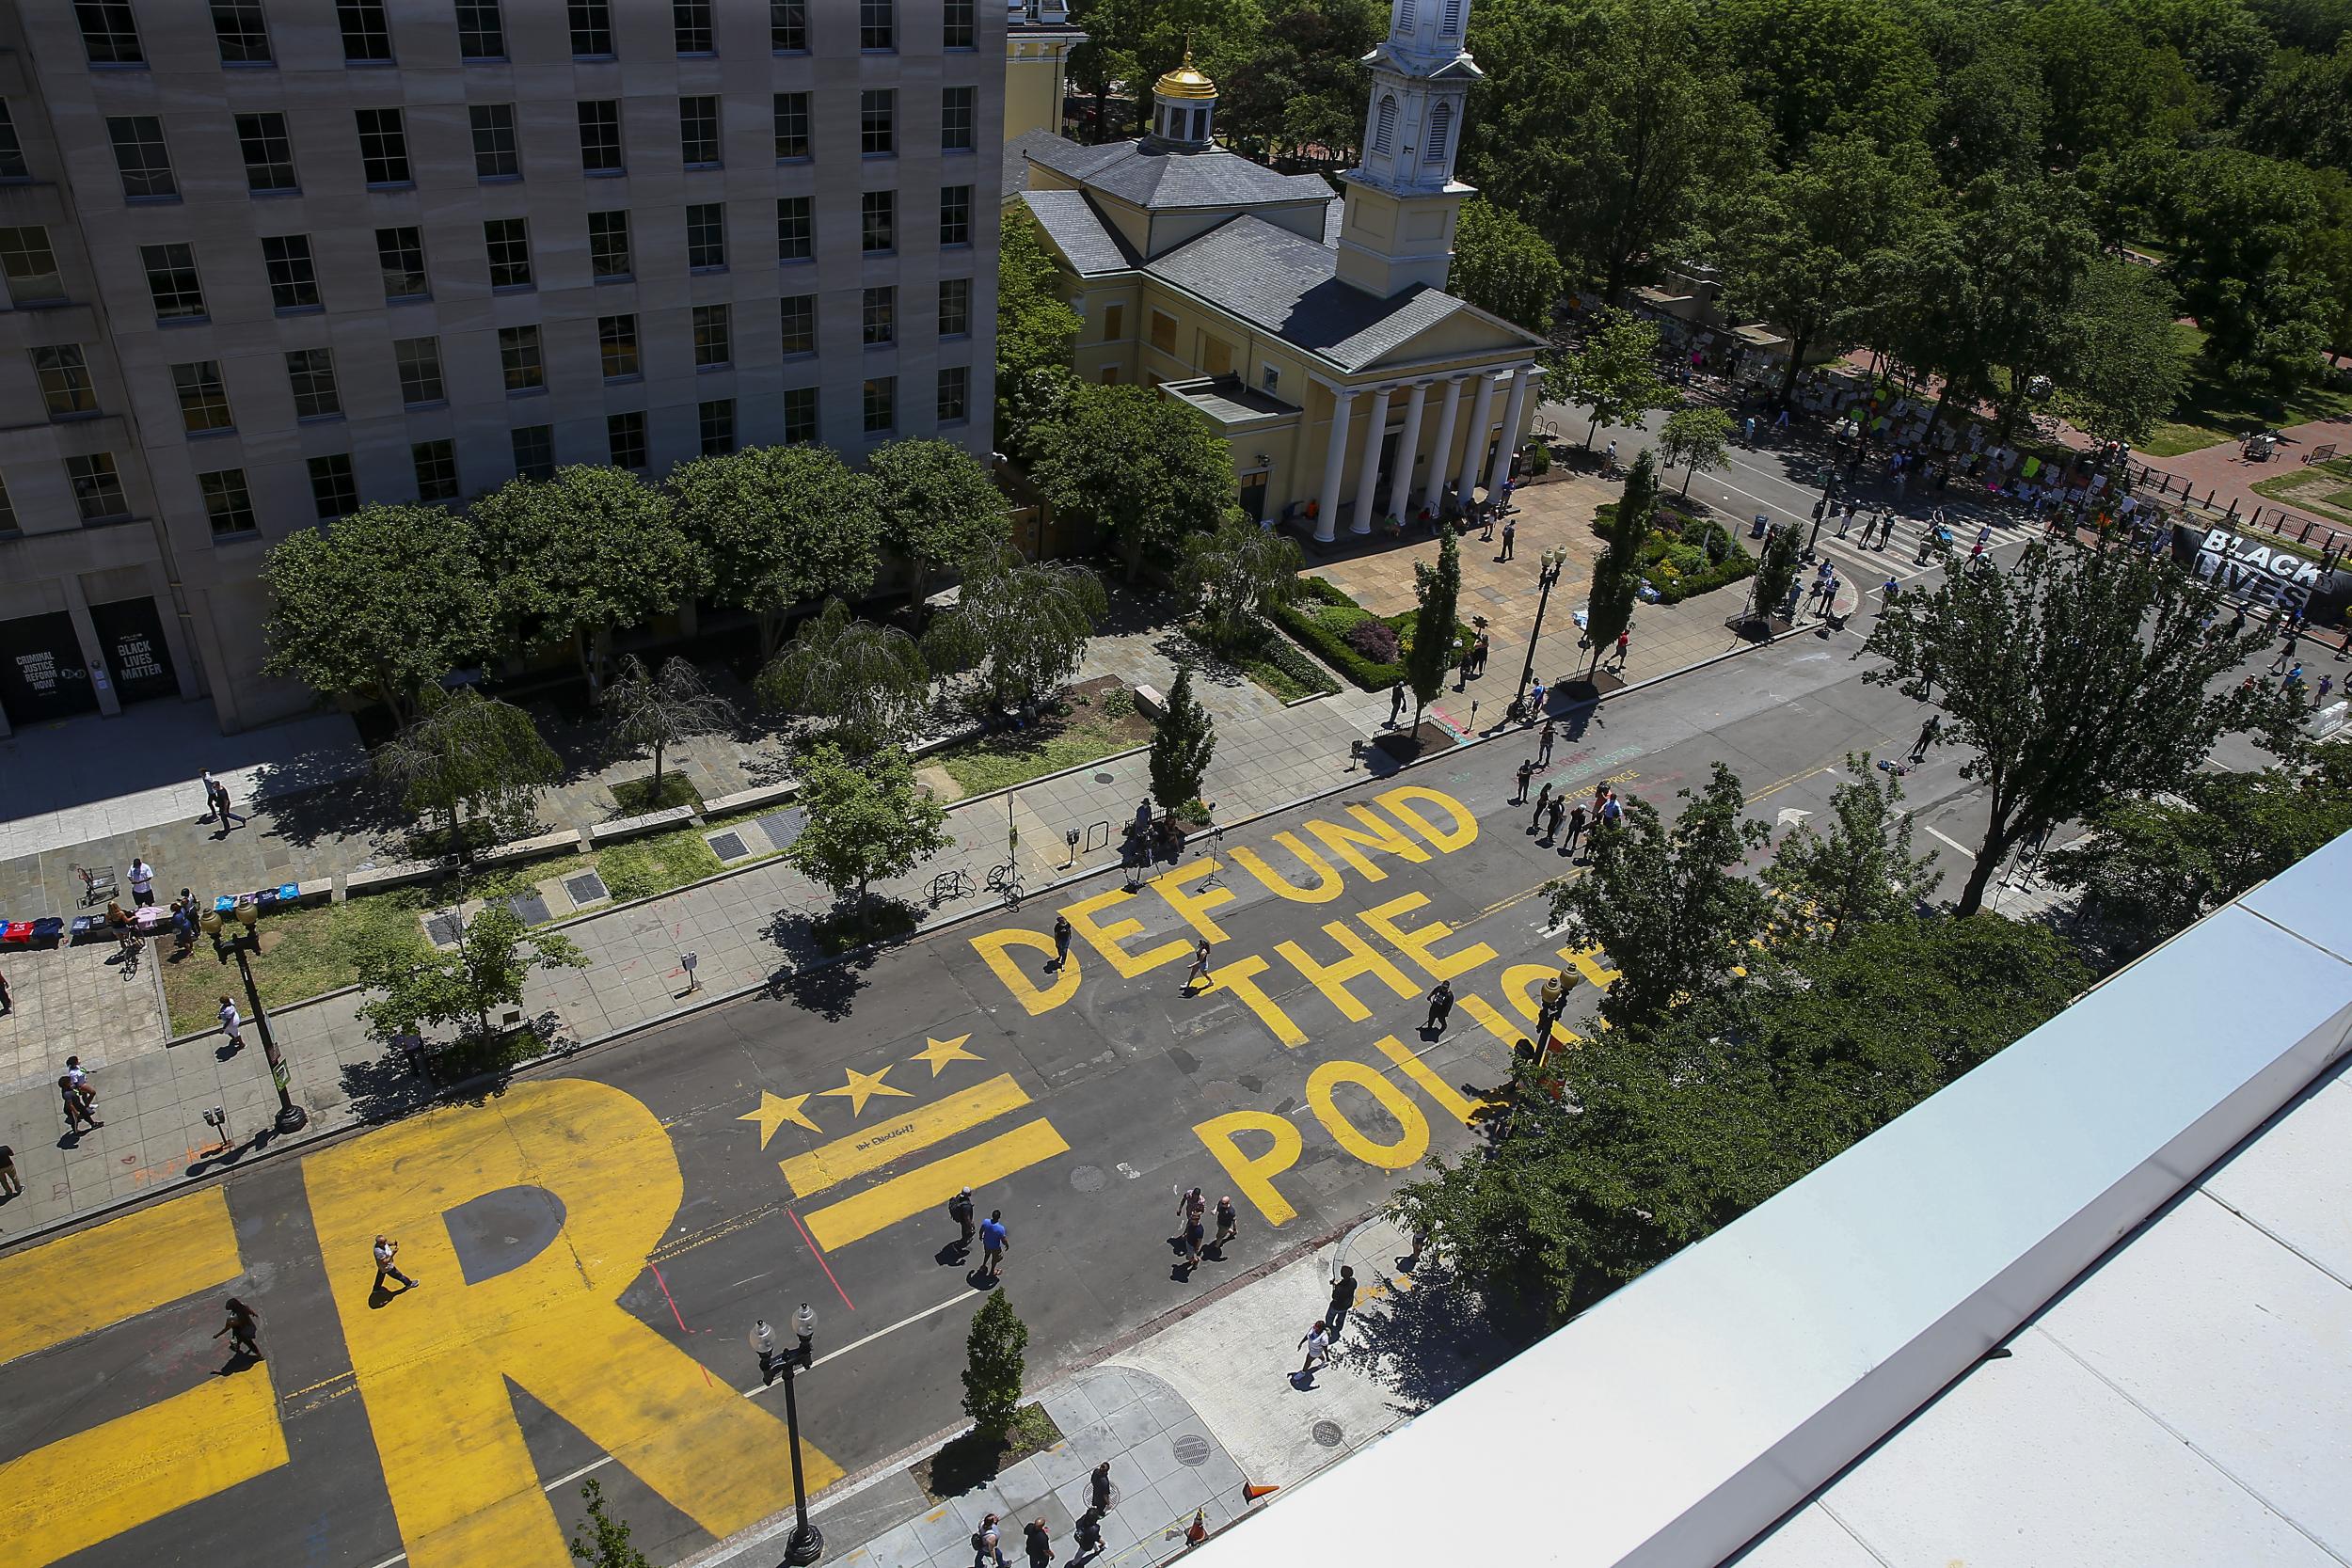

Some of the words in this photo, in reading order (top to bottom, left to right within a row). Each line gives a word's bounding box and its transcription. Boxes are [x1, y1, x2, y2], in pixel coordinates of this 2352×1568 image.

[2202, 529, 2319, 587] BLACK
[2192, 552, 2307, 610] LIVES
[118, 640, 151, 657] BLACK
[16, 651, 56, 665] CRIMINAL
[24, 660, 55, 673] JUSTICE
[123, 653, 152, 668] LIVES
[24, 669, 57, 683] REFORM
[120, 663, 162, 680] MATTER
[33, 678, 56, 690] NOW!
[970, 786, 1479, 1016] DEFUND
[1199, 892, 1499, 1048] THE
[871, 1124, 914, 1146] ENOUGH!
